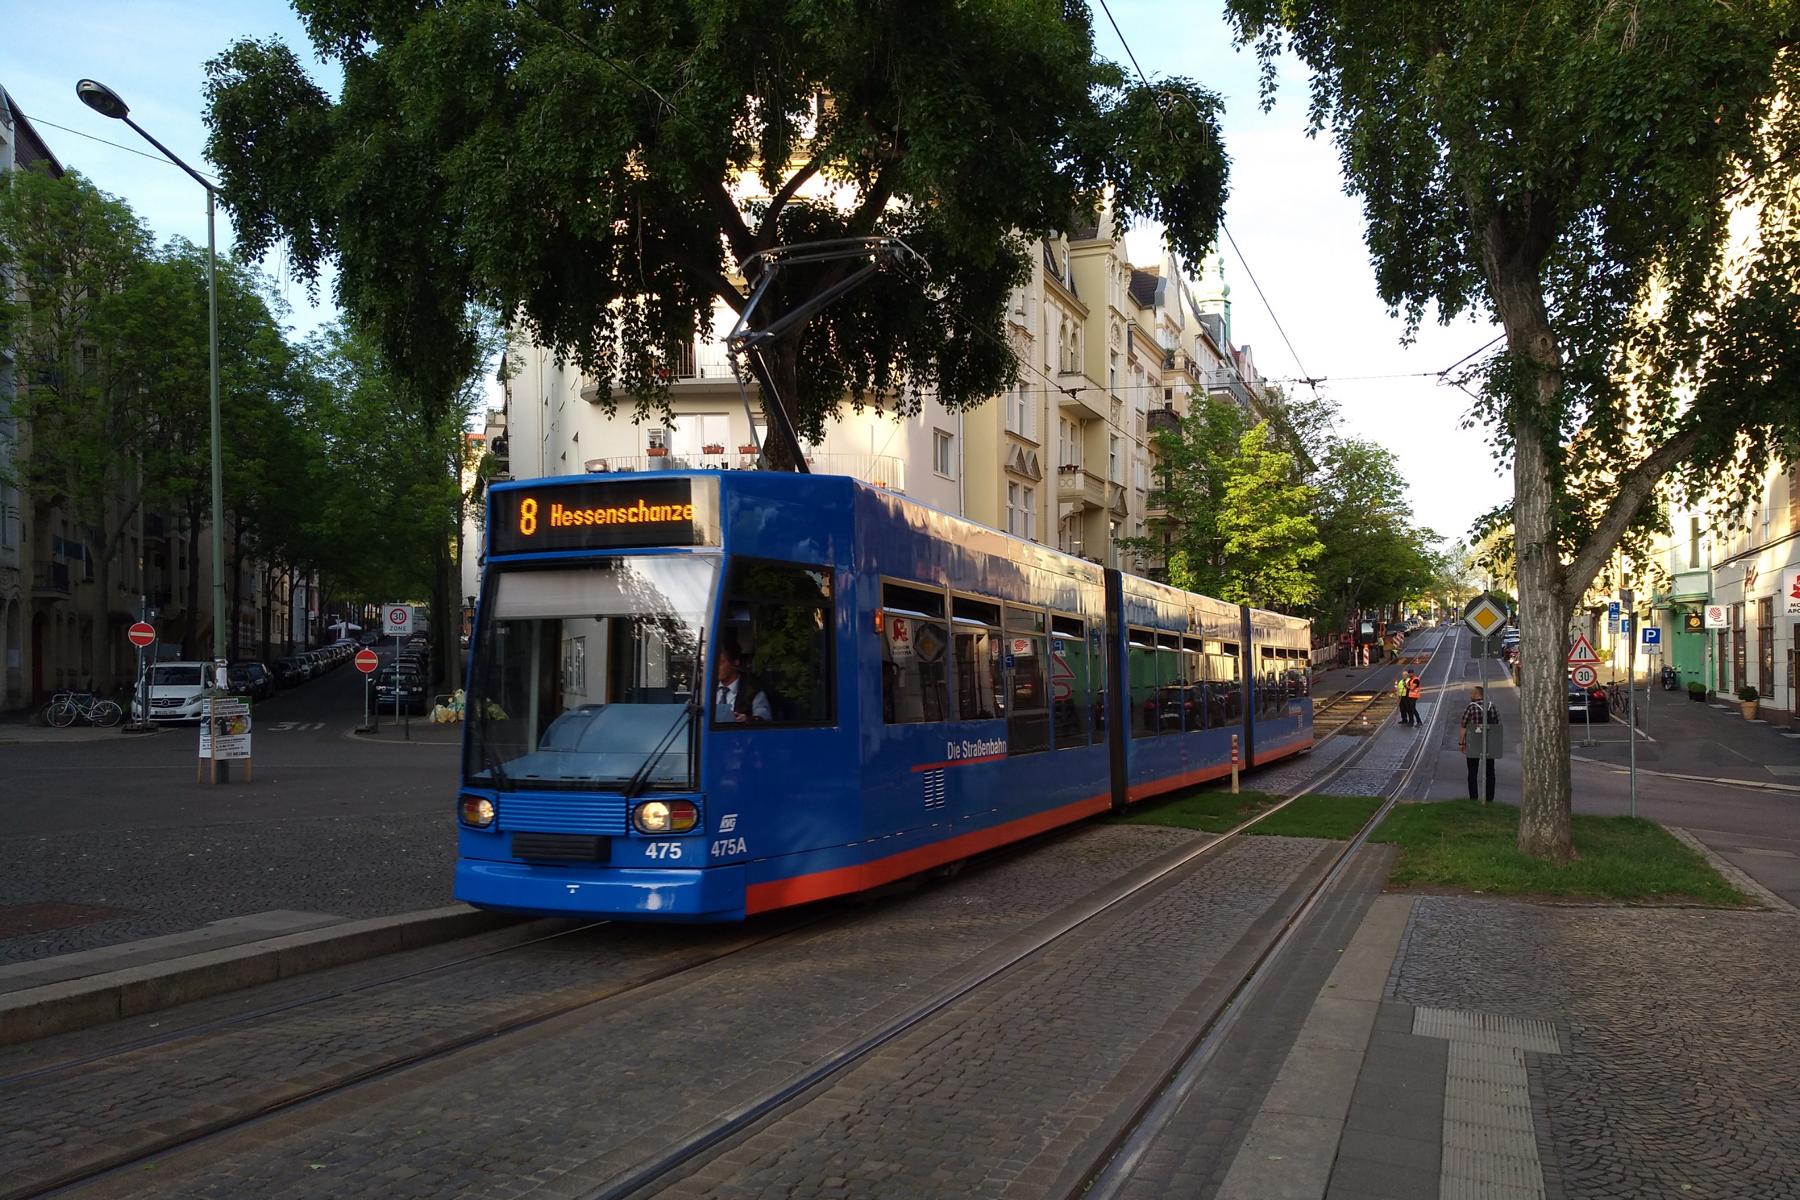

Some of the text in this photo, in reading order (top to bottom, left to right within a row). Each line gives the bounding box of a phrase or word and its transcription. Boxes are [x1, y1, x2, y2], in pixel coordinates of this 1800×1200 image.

[519, 497, 696, 536] 8 Hessenschanze
[392, 612, 403, 621] 30
[1646, 629, 1656, 642] P
[1578, 671, 1589, 681] 30
[947, 737, 1007, 760] Die Straßenbahn
[645, 842, 682, 859] 475
[711, 837, 747, 857] 475A
